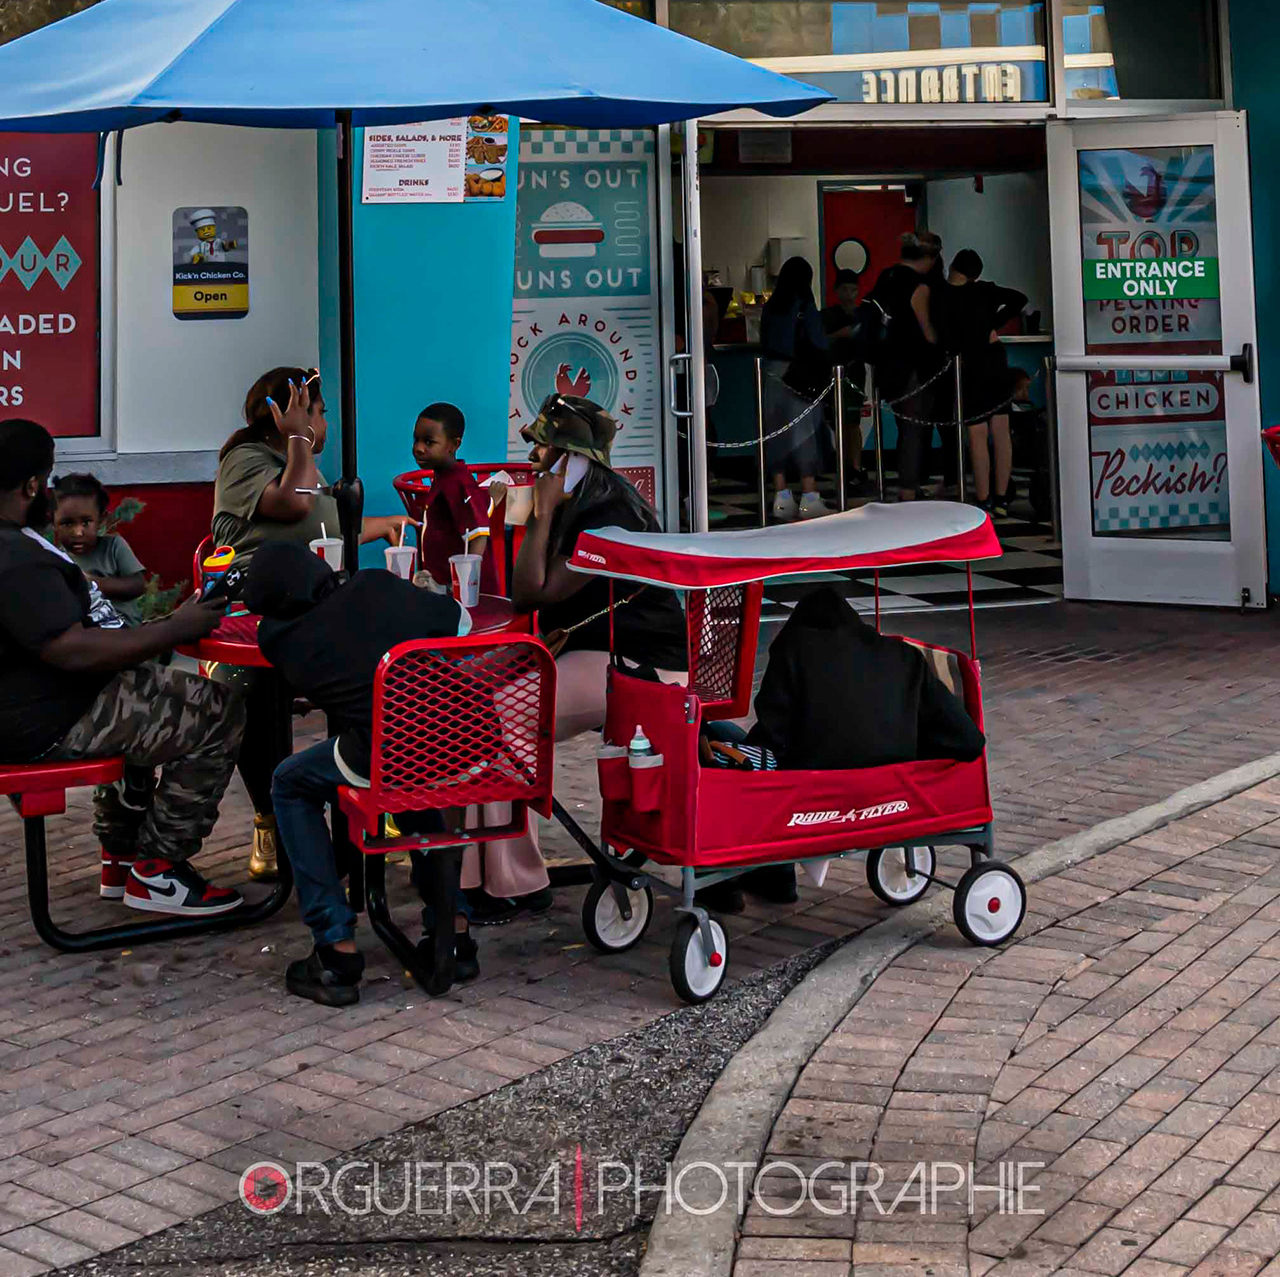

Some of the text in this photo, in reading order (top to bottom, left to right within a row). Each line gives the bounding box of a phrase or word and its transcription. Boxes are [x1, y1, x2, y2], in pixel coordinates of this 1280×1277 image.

[369, 134, 394, 142] SIDES,
[396, 134, 429, 142] SALADS,
[439, 134, 462, 142] MORE
[584, 168, 641, 189] OUT
[1096, 229, 1200, 259] TOP
[175, 272, 199, 280] Kick'n
[200, 271, 231, 279] Chicken
[585, 267, 642, 289] OUT
[1095, 260, 1205, 279] ENTRANCE
[193, 291, 228, 304] Open
[1122, 279, 1178, 297] ONLY
[1111, 314, 1190, 334] ORDER
[558, 312, 638, 381] AROUND
[1096, 389, 1210, 410] CHICKEN
[1091, 448, 1228, 499] Peckish?
[787, 800, 910, 827] RADIO FLYER
